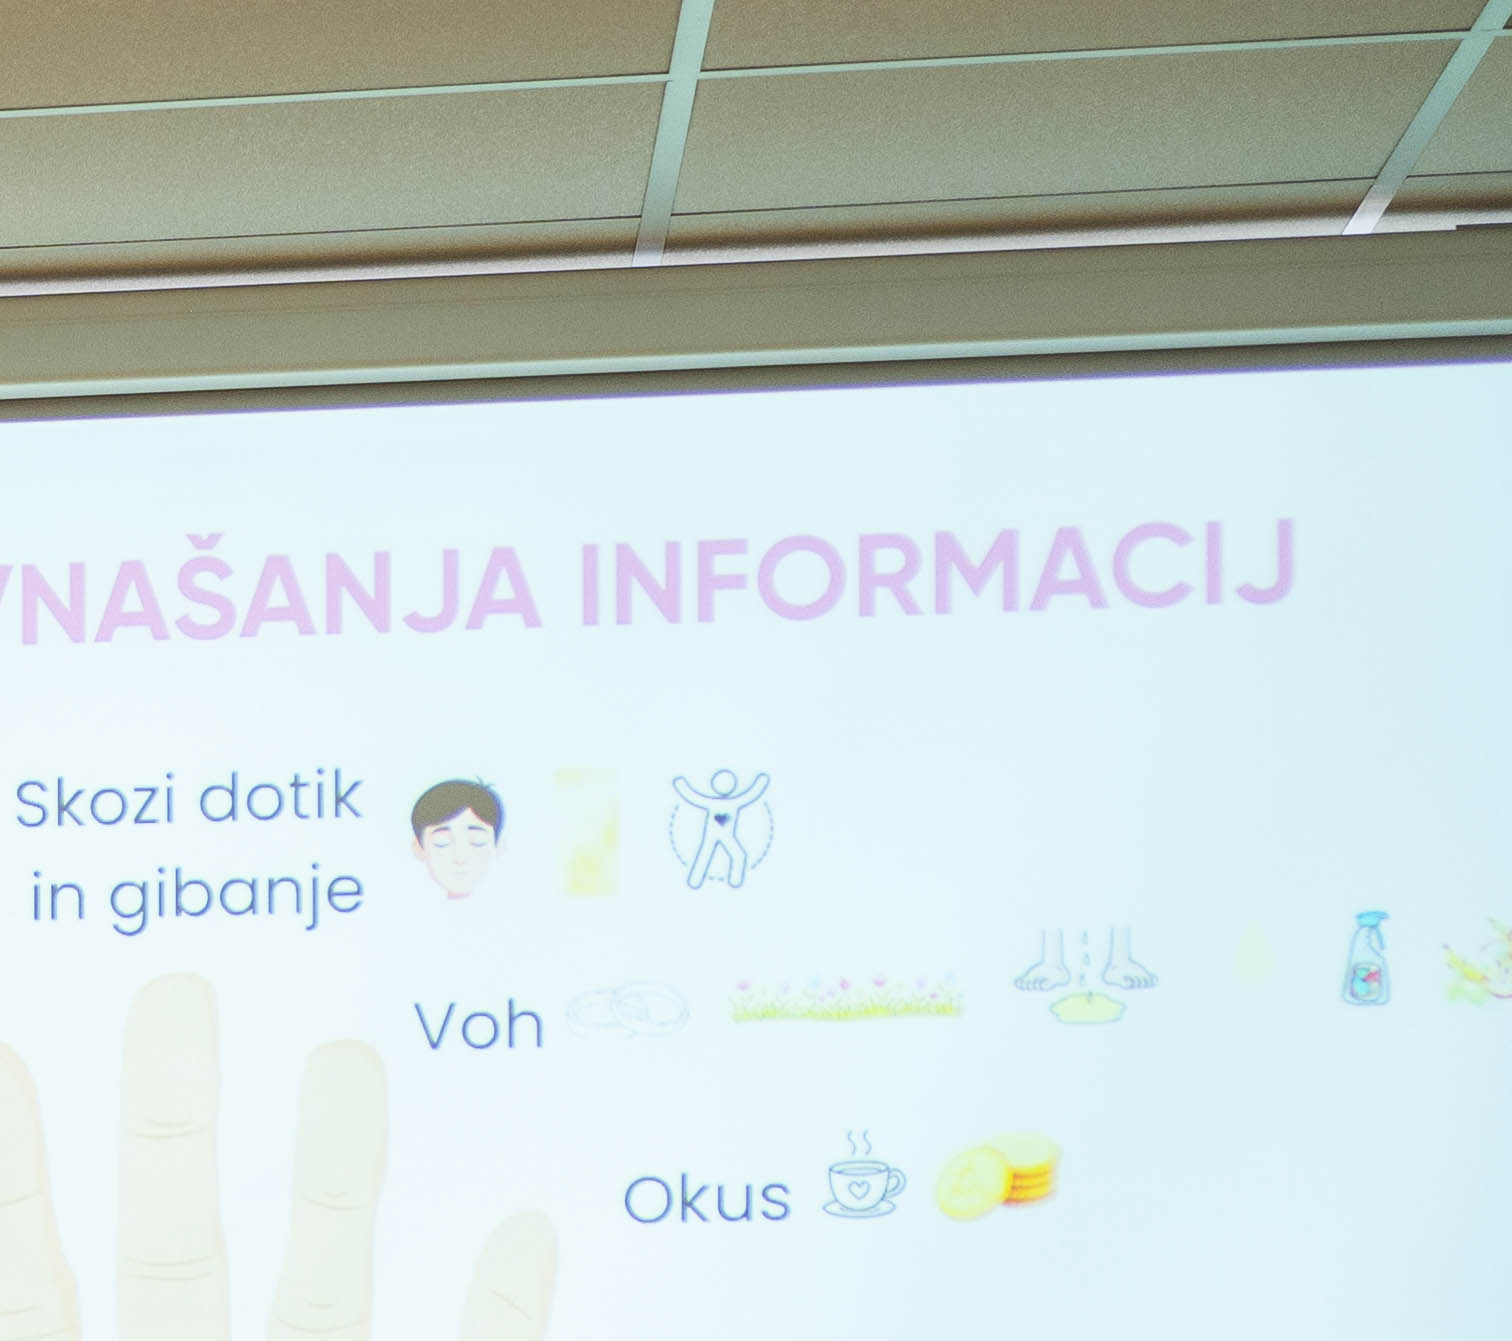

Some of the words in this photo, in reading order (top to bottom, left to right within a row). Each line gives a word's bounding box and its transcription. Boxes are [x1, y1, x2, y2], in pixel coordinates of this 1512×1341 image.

[581, 518, 1295, 627] INFORMACIJ
[15, 771, 174, 829] Skozi
[198, 766, 363, 823] dotik
[31, 869, 85, 922] in
[109, 861, 365, 938] gibanje
[413, 997, 544, 1051] Voh
[623, 1171, 792, 1225] Okus
